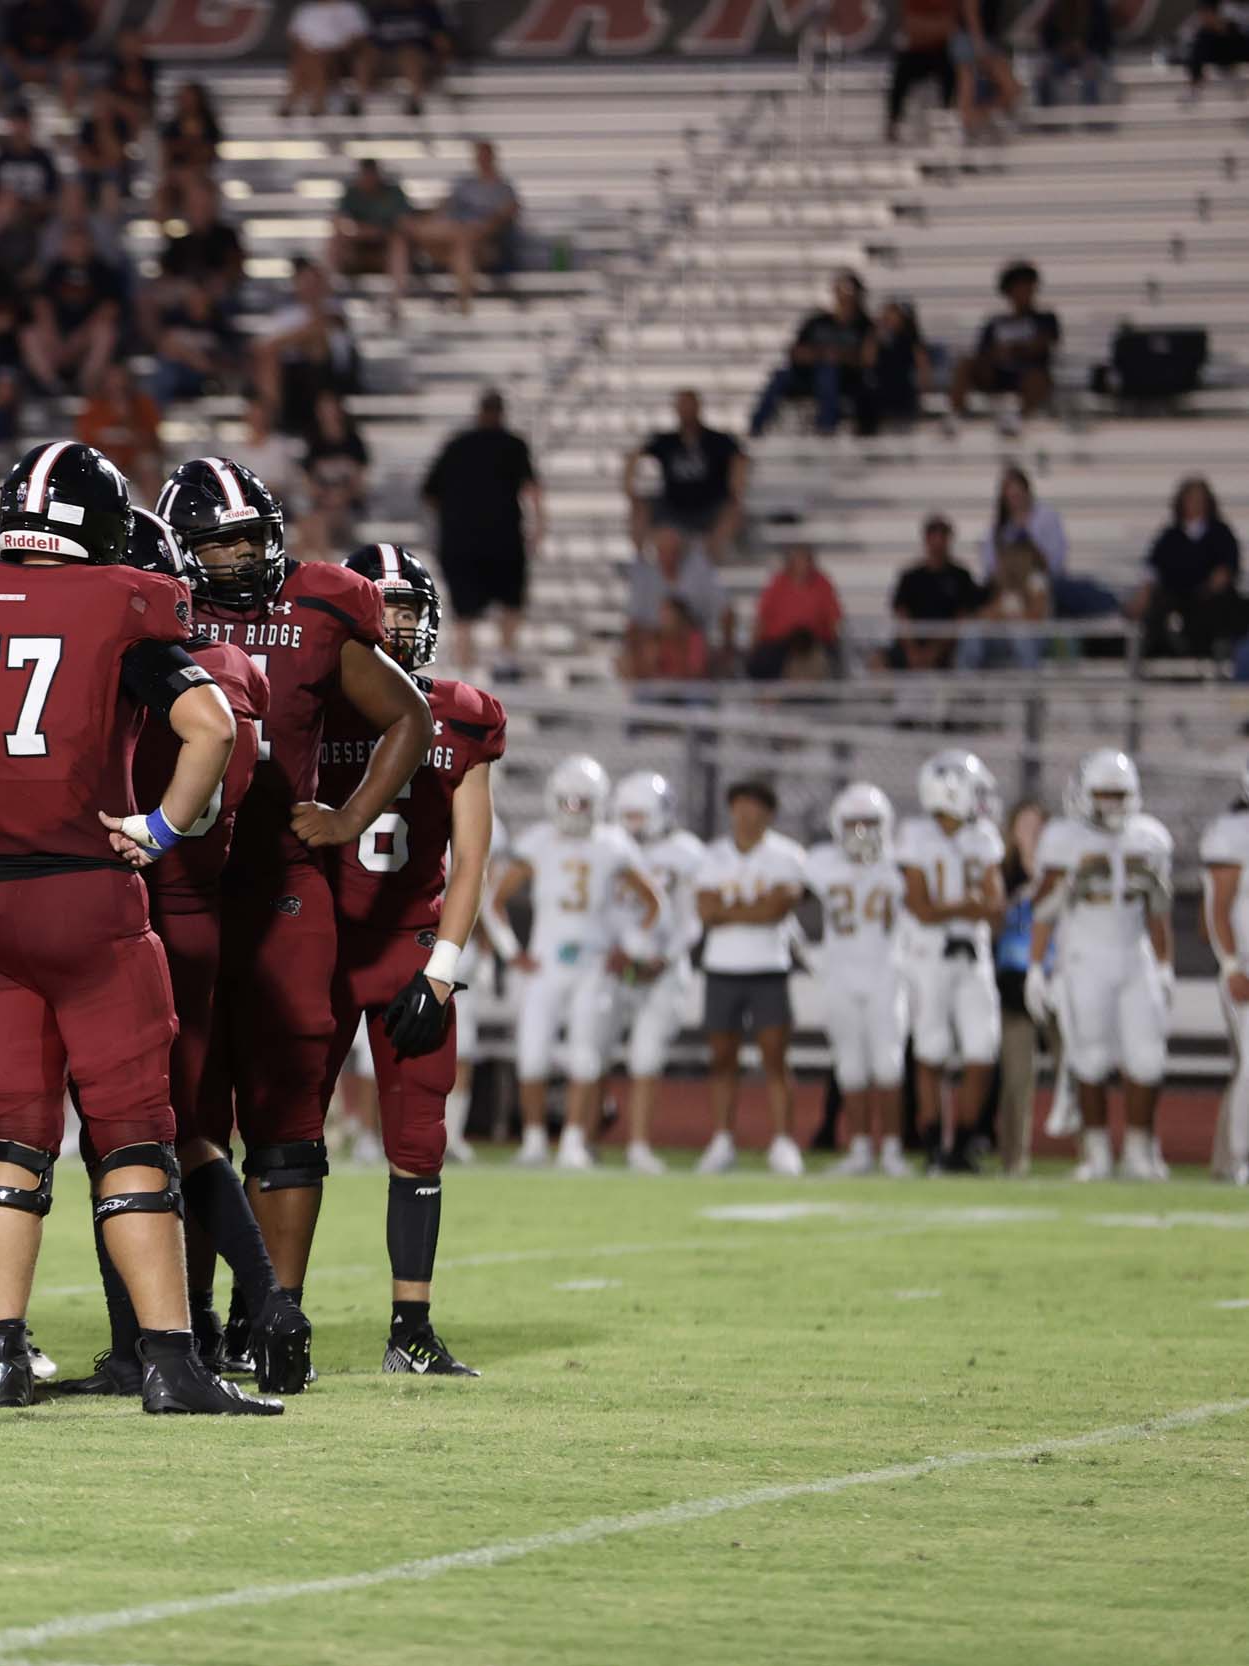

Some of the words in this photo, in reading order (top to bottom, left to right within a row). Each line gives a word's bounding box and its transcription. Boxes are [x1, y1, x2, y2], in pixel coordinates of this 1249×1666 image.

[4, 534, 61, 551] Riddell
[244, 624, 303, 648] RIDGE
[358, 781, 411, 873] 6
[561, 859, 590, 913] 3
